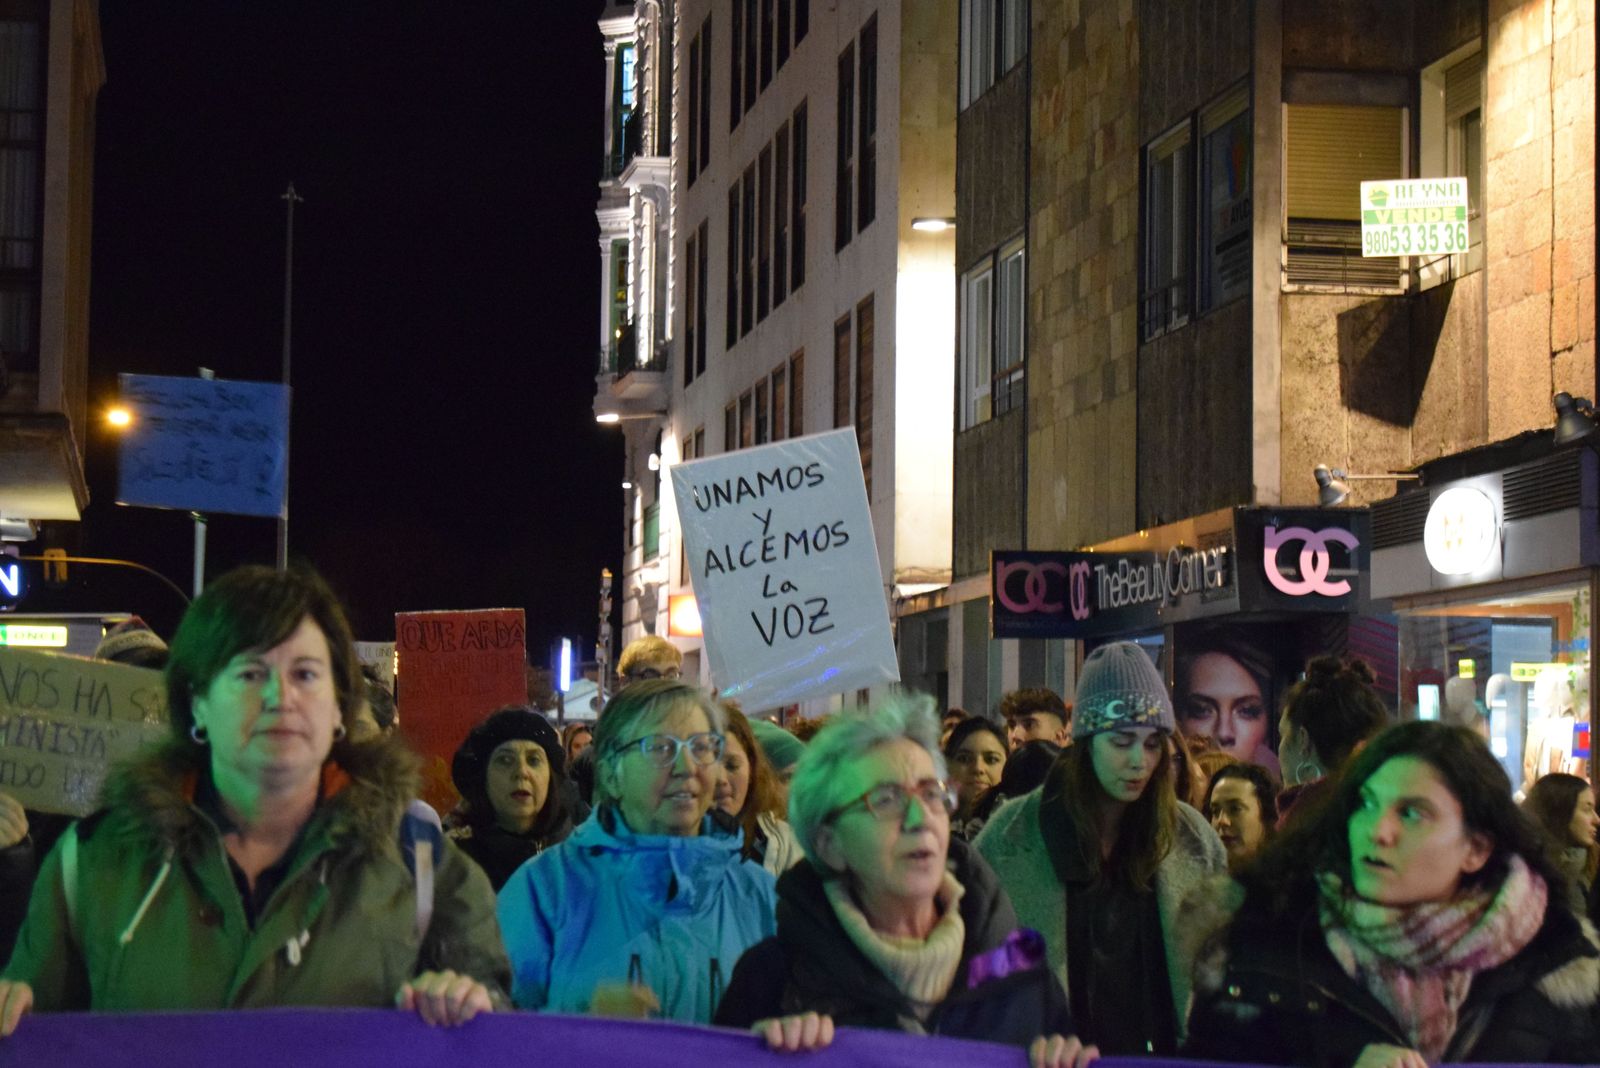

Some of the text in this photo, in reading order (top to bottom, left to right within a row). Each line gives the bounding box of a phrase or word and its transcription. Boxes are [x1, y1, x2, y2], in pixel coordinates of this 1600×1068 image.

[1375, 207, 1457, 225] VENDE
[693, 462, 825, 513] UNAMOS
[752, 508, 772, 537] Y
[704, 520, 850, 578] ALCEMOS
[751, 597, 835, 648] VOZ
